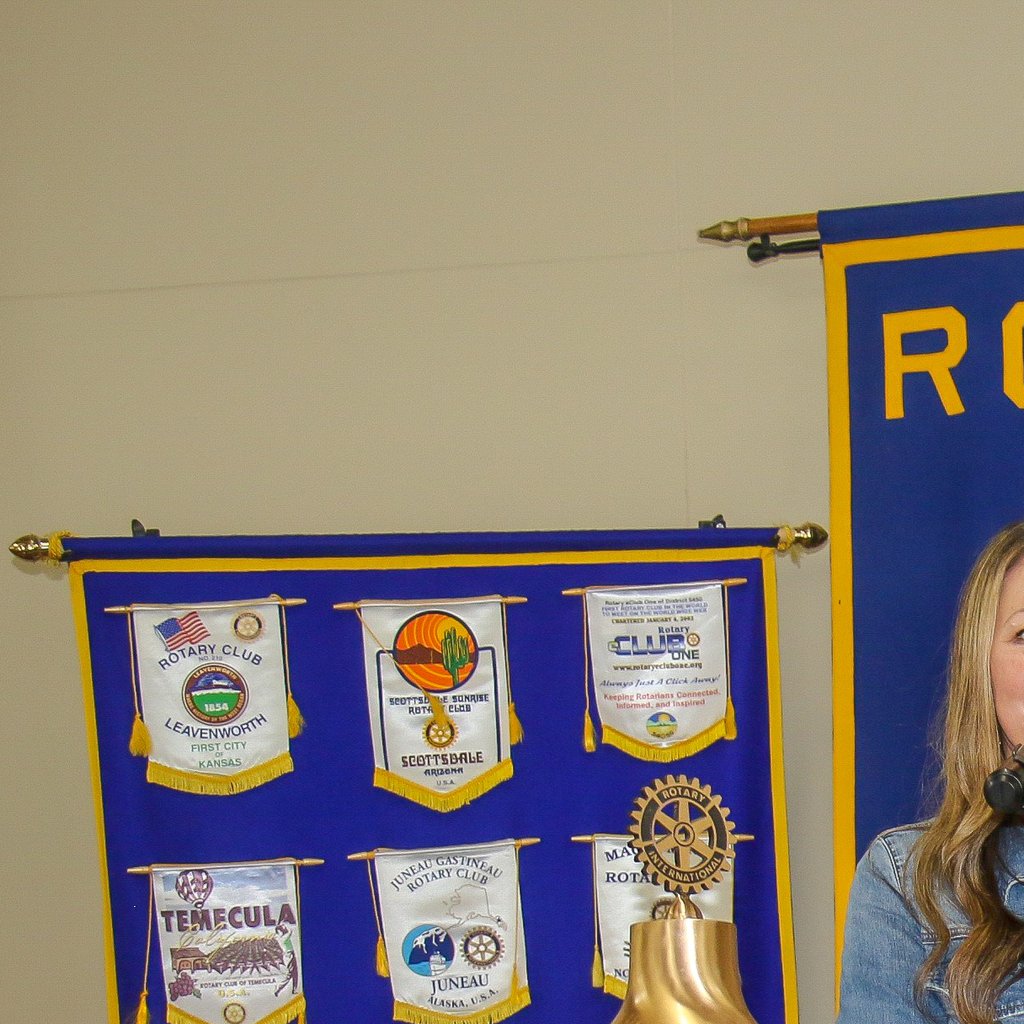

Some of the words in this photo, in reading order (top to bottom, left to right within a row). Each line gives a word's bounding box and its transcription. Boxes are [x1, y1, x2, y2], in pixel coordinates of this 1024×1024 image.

[158, 644, 216, 670] ROTARY
[222, 644, 263, 666] CLUB
[672, 650, 699, 660] ONE
[389, 696, 448, 705] SCOTTSDLE
[604, 693, 634, 701] Keeping
[636, 691, 674, 700] Rotarians
[204, 703, 229, 712] 1854
[449, 705, 471, 713] CLUB
[656, 700, 670, 708] and
[673, 699, 705, 708] Inspired
[165, 714, 267, 739] LEAVENWORTH
[191, 742, 220, 752] FIRST
[224, 742, 247, 750] CITY
[199, 759, 242, 768] KANSAS
[402, 752, 483, 767] SCOTTSDALE
[424, 768, 463, 776] ARIZONA
[662, 787, 706, 802] ROTARY
[649, 851, 722, 882] INTERNATIONAL
[390, 859, 433, 891] JUNEAU
[436, 855, 503, 879] GASTINEAU
[407, 868, 452, 893] ROTARY
[457, 868, 488, 885] CLUB
[161, 904, 296, 932] TEMECULA
[430, 973, 489, 996] JUNEAU
